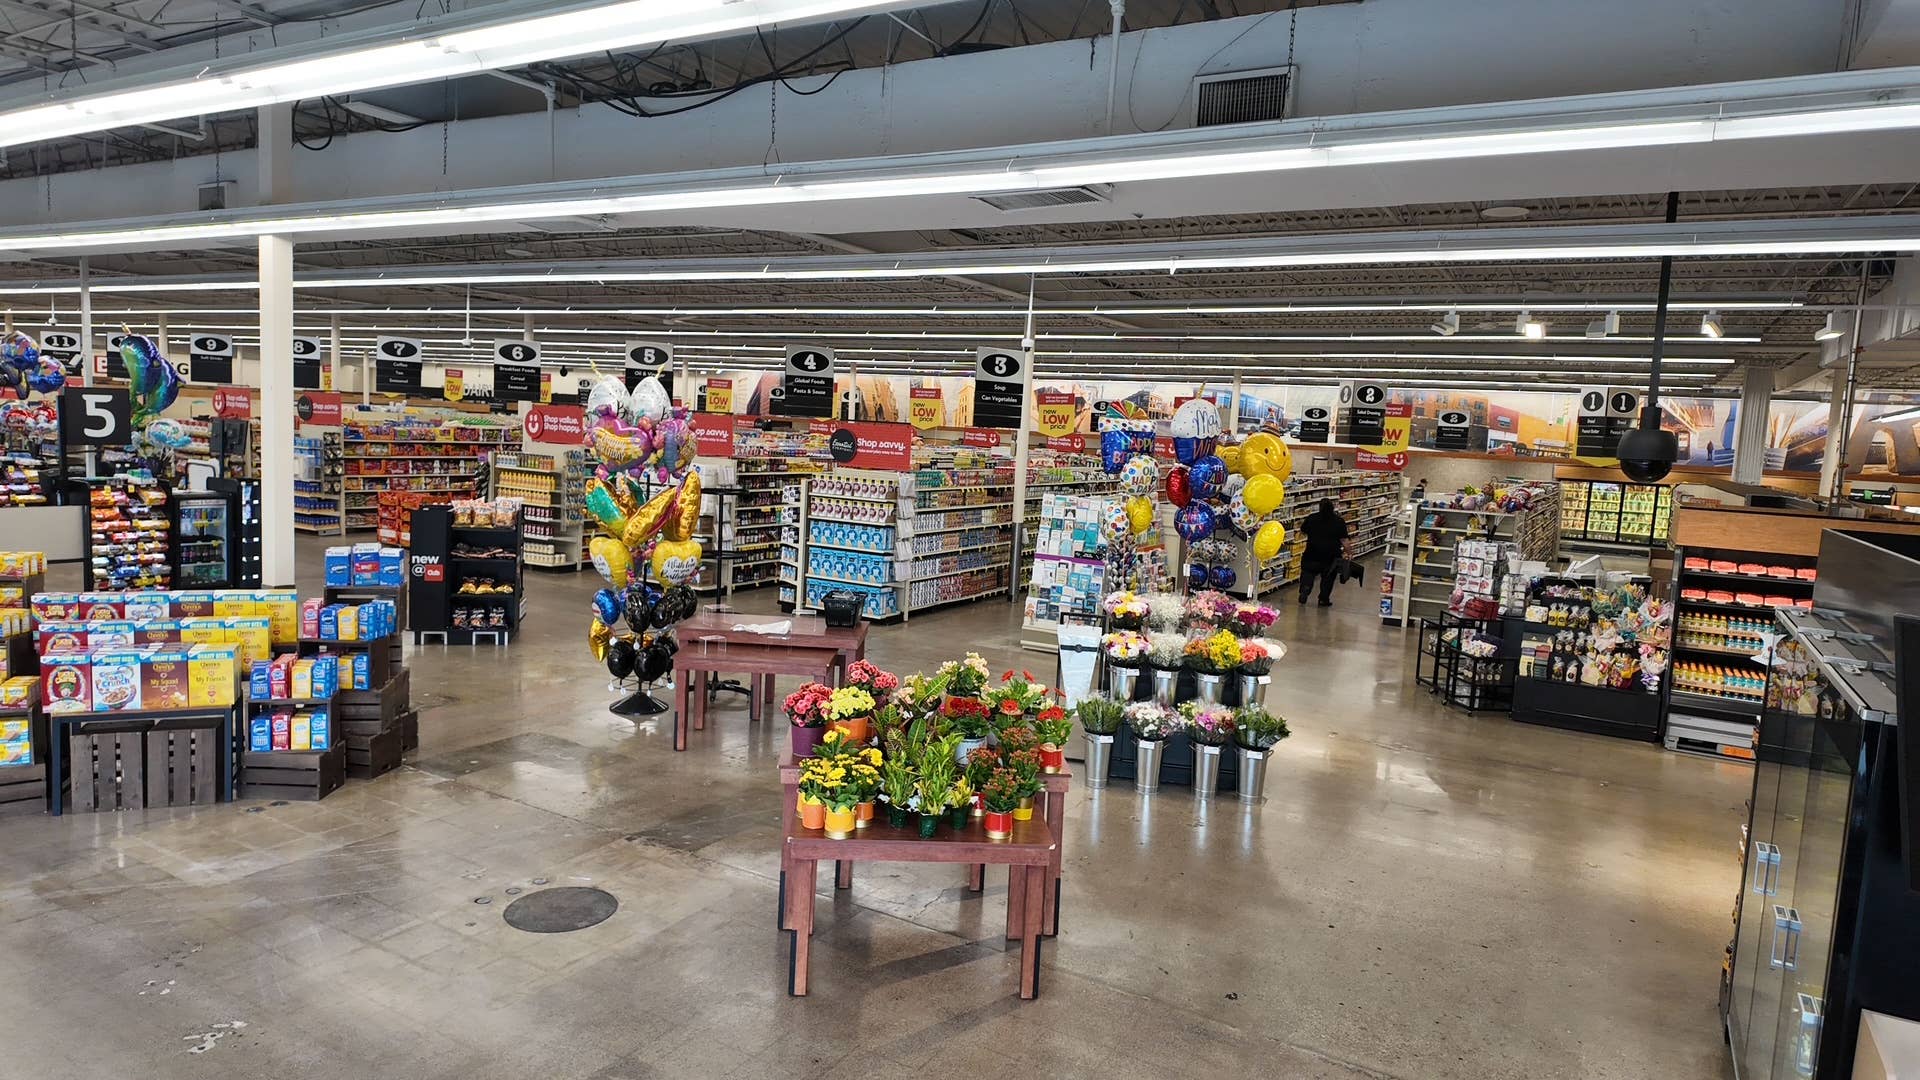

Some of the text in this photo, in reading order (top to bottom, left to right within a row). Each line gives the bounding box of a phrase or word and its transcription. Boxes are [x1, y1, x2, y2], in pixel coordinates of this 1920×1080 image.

[51, 336, 70, 347] 11
[206, 339, 217, 350] 9
[294, 341, 304, 353] 8
[393, 342, 406, 356] 7
[511, 346, 524, 360] 6
[643, 348, 656, 363] 5
[804, 354, 817, 370] 4
[994, 356, 1007, 374] 3
[446, 382, 460, 393] LOW
[992, 395, 1018, 403] Vegetables
[1365, 387, 1375, 402] 2
[709, 396, 728, 405] LOW
[1590, 393, 1596, 410] 1
[1620, 395, 1626, 411] 1
[82, 393, 116, 438] 5
[912, 407, 936, 417] LOW
[1312, 409, 1320, 418] 3
[543, 415, 579, 425] Shop value.
[1043, 414, 1070, 425] LOW
[543, 423, 581, 434] Shop happy.
[705, 429, 729, 439] savvy.
[857, 437, 906, 451] Shop savvy.
[411, 555, 440, 564] new
[411, 563, 426, 577] @
